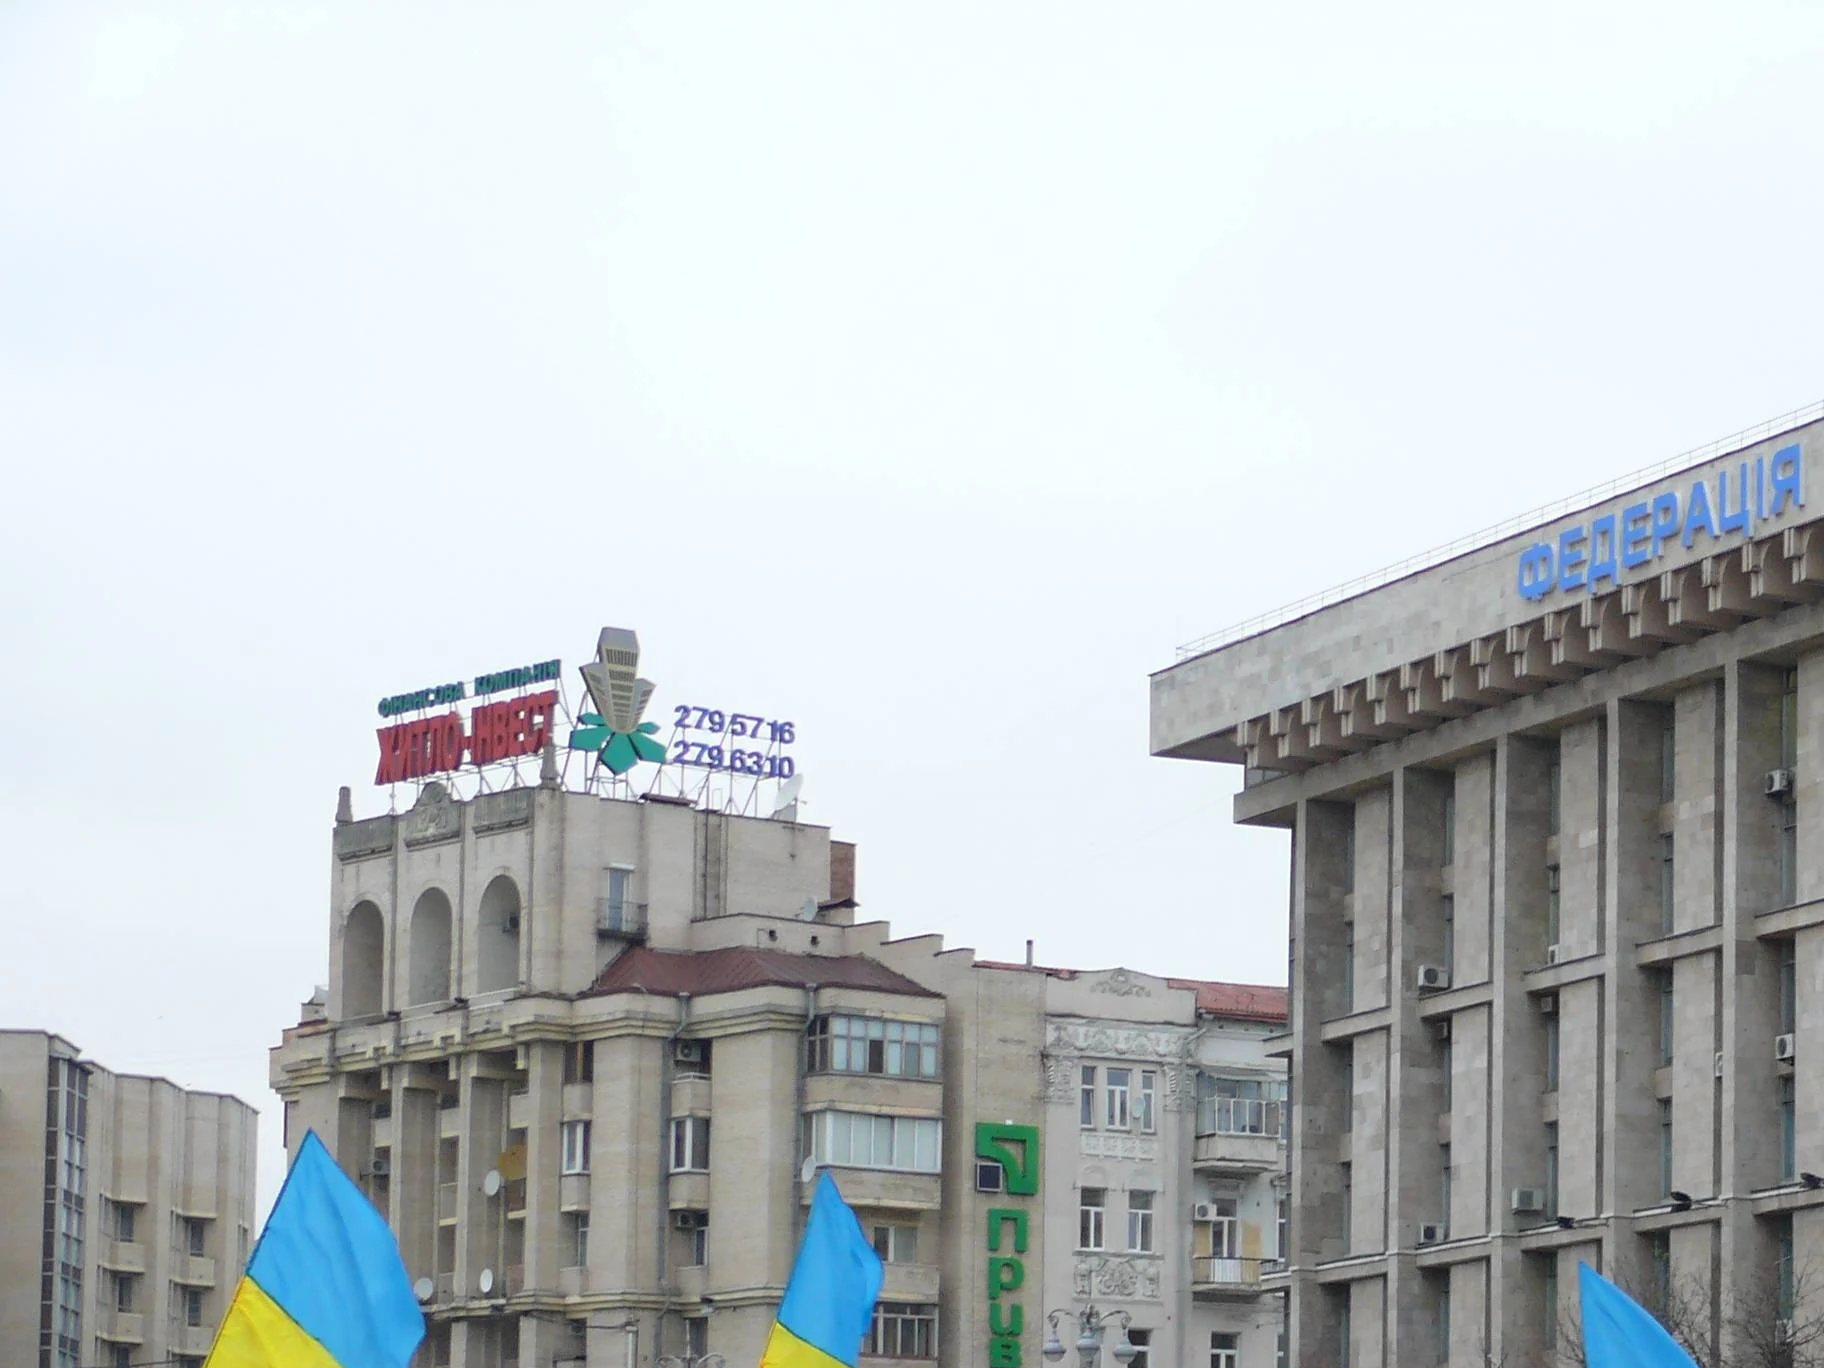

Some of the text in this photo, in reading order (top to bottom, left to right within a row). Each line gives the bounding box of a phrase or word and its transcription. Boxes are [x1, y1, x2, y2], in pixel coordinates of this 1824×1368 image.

[1517, 443, 1806, 600] ФЕДЕРАЦІЯ
[674, 705, 796, 744] 279 5716
[673, 740, 795, 777] 279 6310
